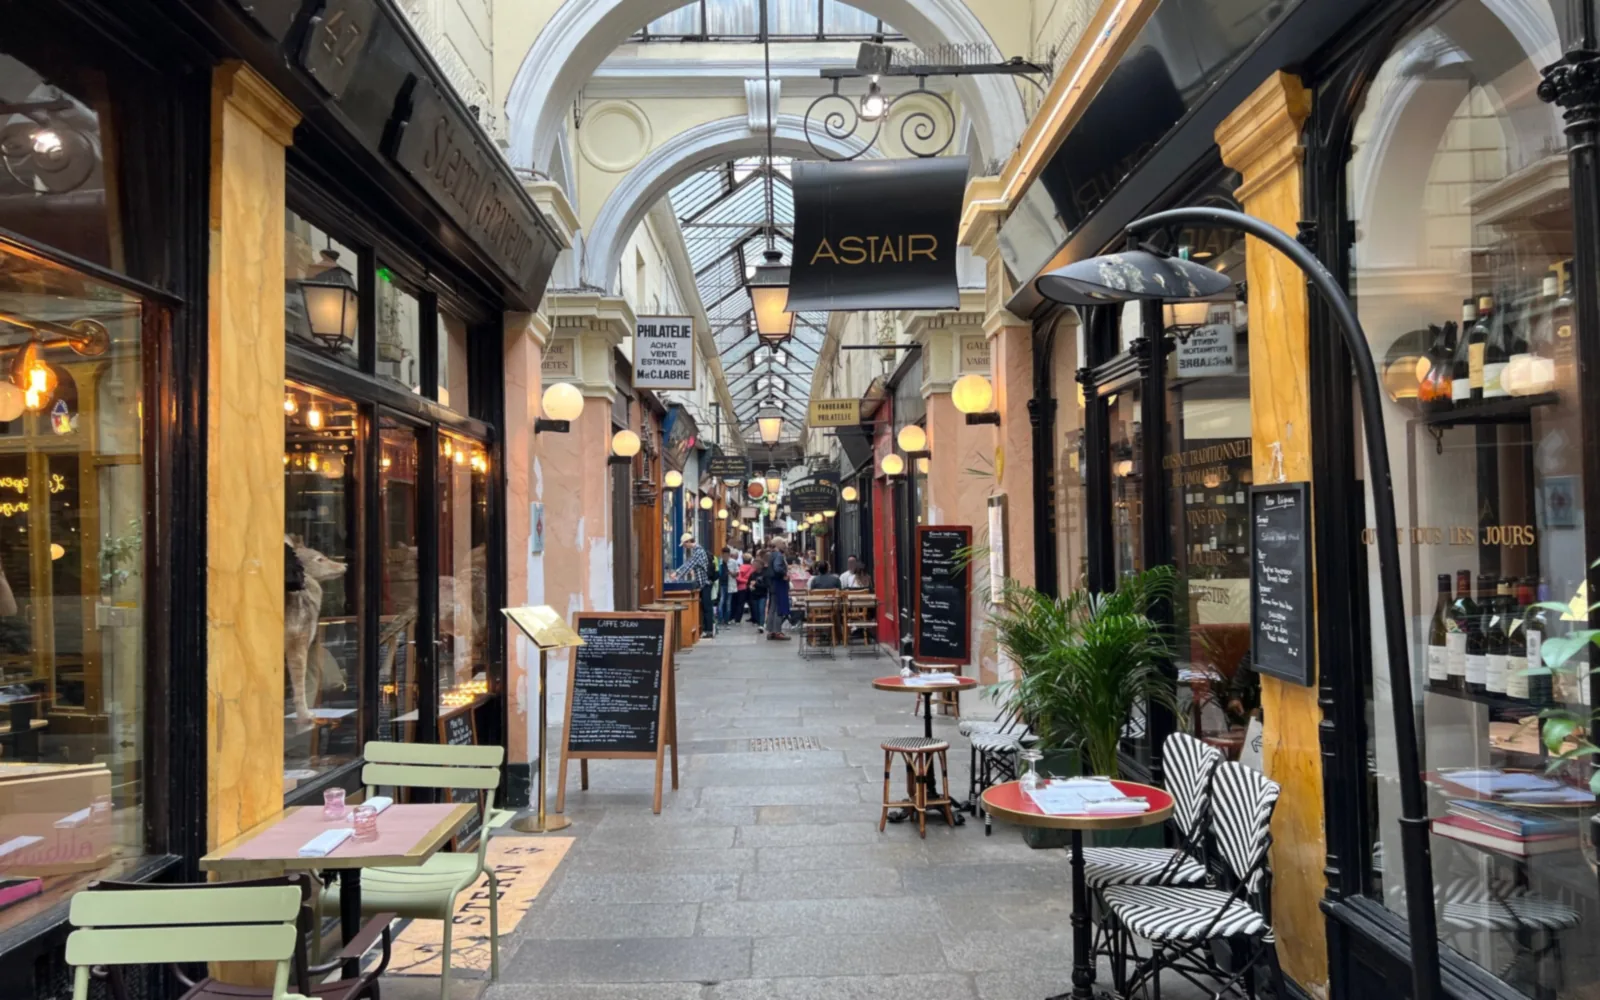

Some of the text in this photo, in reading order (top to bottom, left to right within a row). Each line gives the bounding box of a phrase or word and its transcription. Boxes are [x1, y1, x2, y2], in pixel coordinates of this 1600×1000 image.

[810, 234, 938, 265] ASTAIR
[650, 341, 677, 349] ACHAT
[650, 350, 677, 358] VENTE
[641, 358, 687, 366] ESTIMATION
[1186, 508, 1227, 525] VINS FINS
[1409, 527, 1442, 545] TOUS
[1448, 526, 1476, 545] LES
[1482, 525, 1535, 546] JOURS
